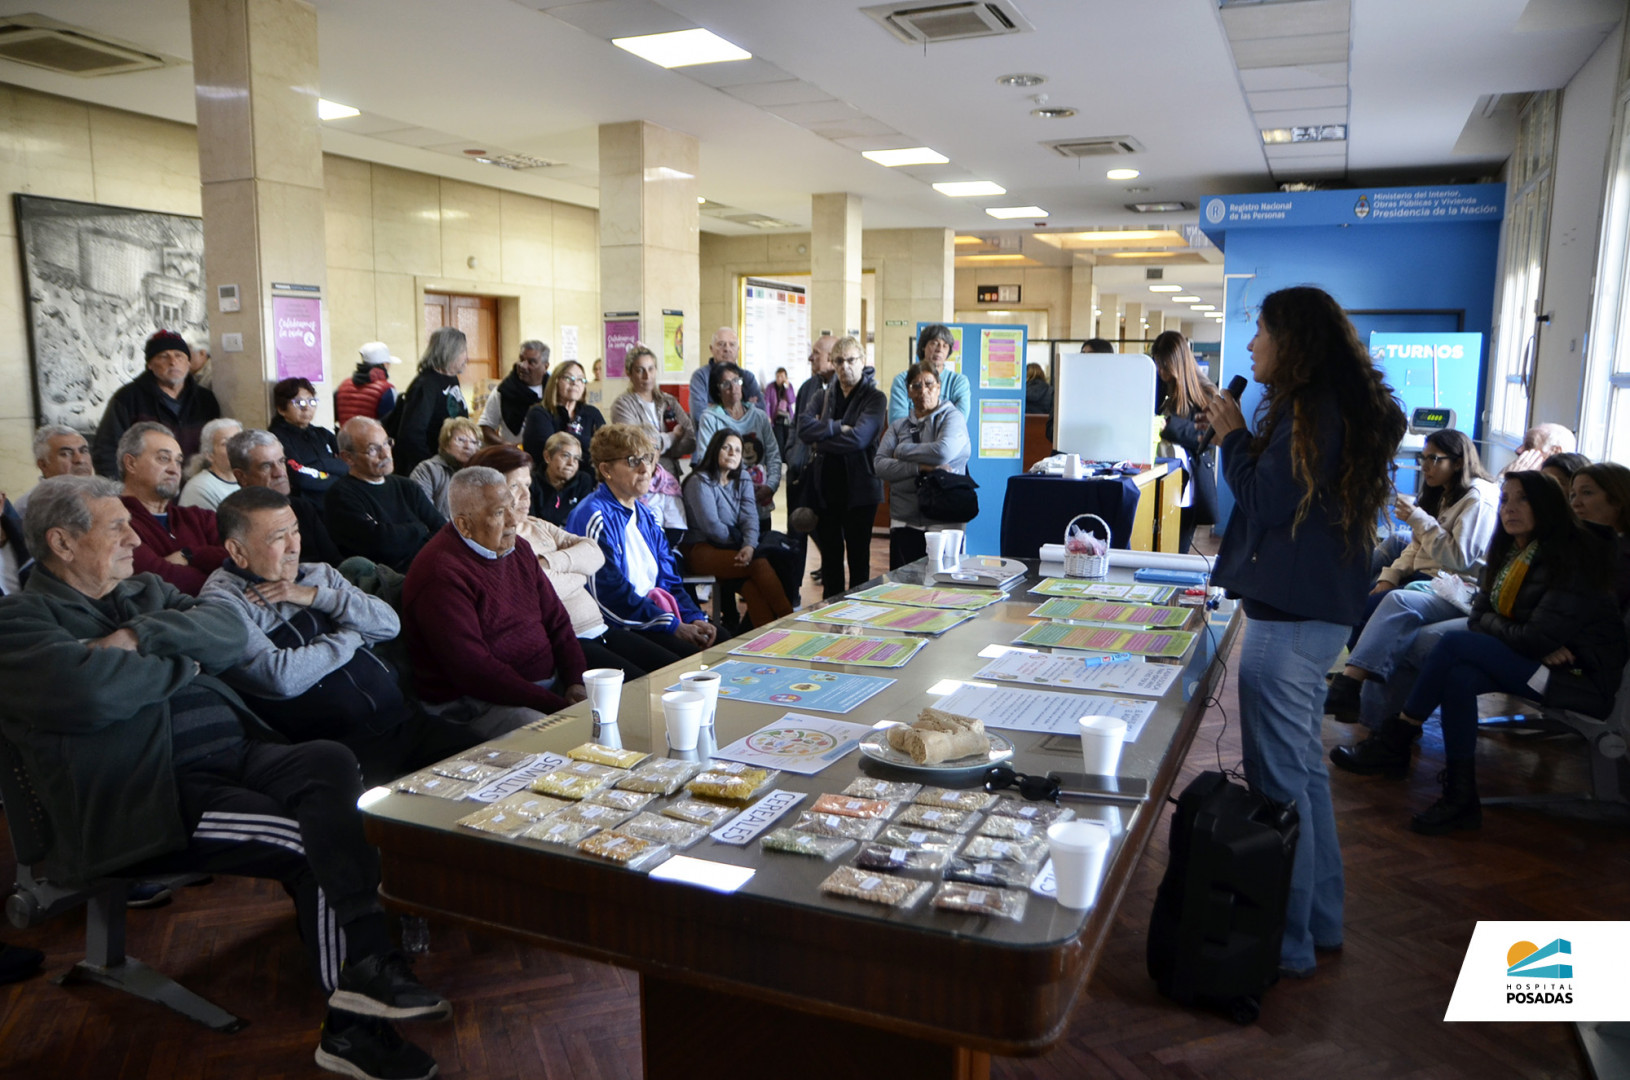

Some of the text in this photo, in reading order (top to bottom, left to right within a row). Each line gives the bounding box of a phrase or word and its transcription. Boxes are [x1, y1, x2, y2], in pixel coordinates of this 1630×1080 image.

[1373, 190, 1461, 201] Ministerio del Interior,
[1229, 202, 1293, 213] Registro Nacional
[1373, 200, 1397, 208] Obras
[1441, 197, 1477, 205] Vivienda
[1229, 212, 1239, 221] de
[1252, 211, 1286, 219] Personas
[1373, 204, 1498, 218] Presidencia de la Nación
[1386, 344, 1464, 359] TURNOS
[479, 756, 563, 800] SEMILLAS
[722, 792, 796, 841] CEREALES
